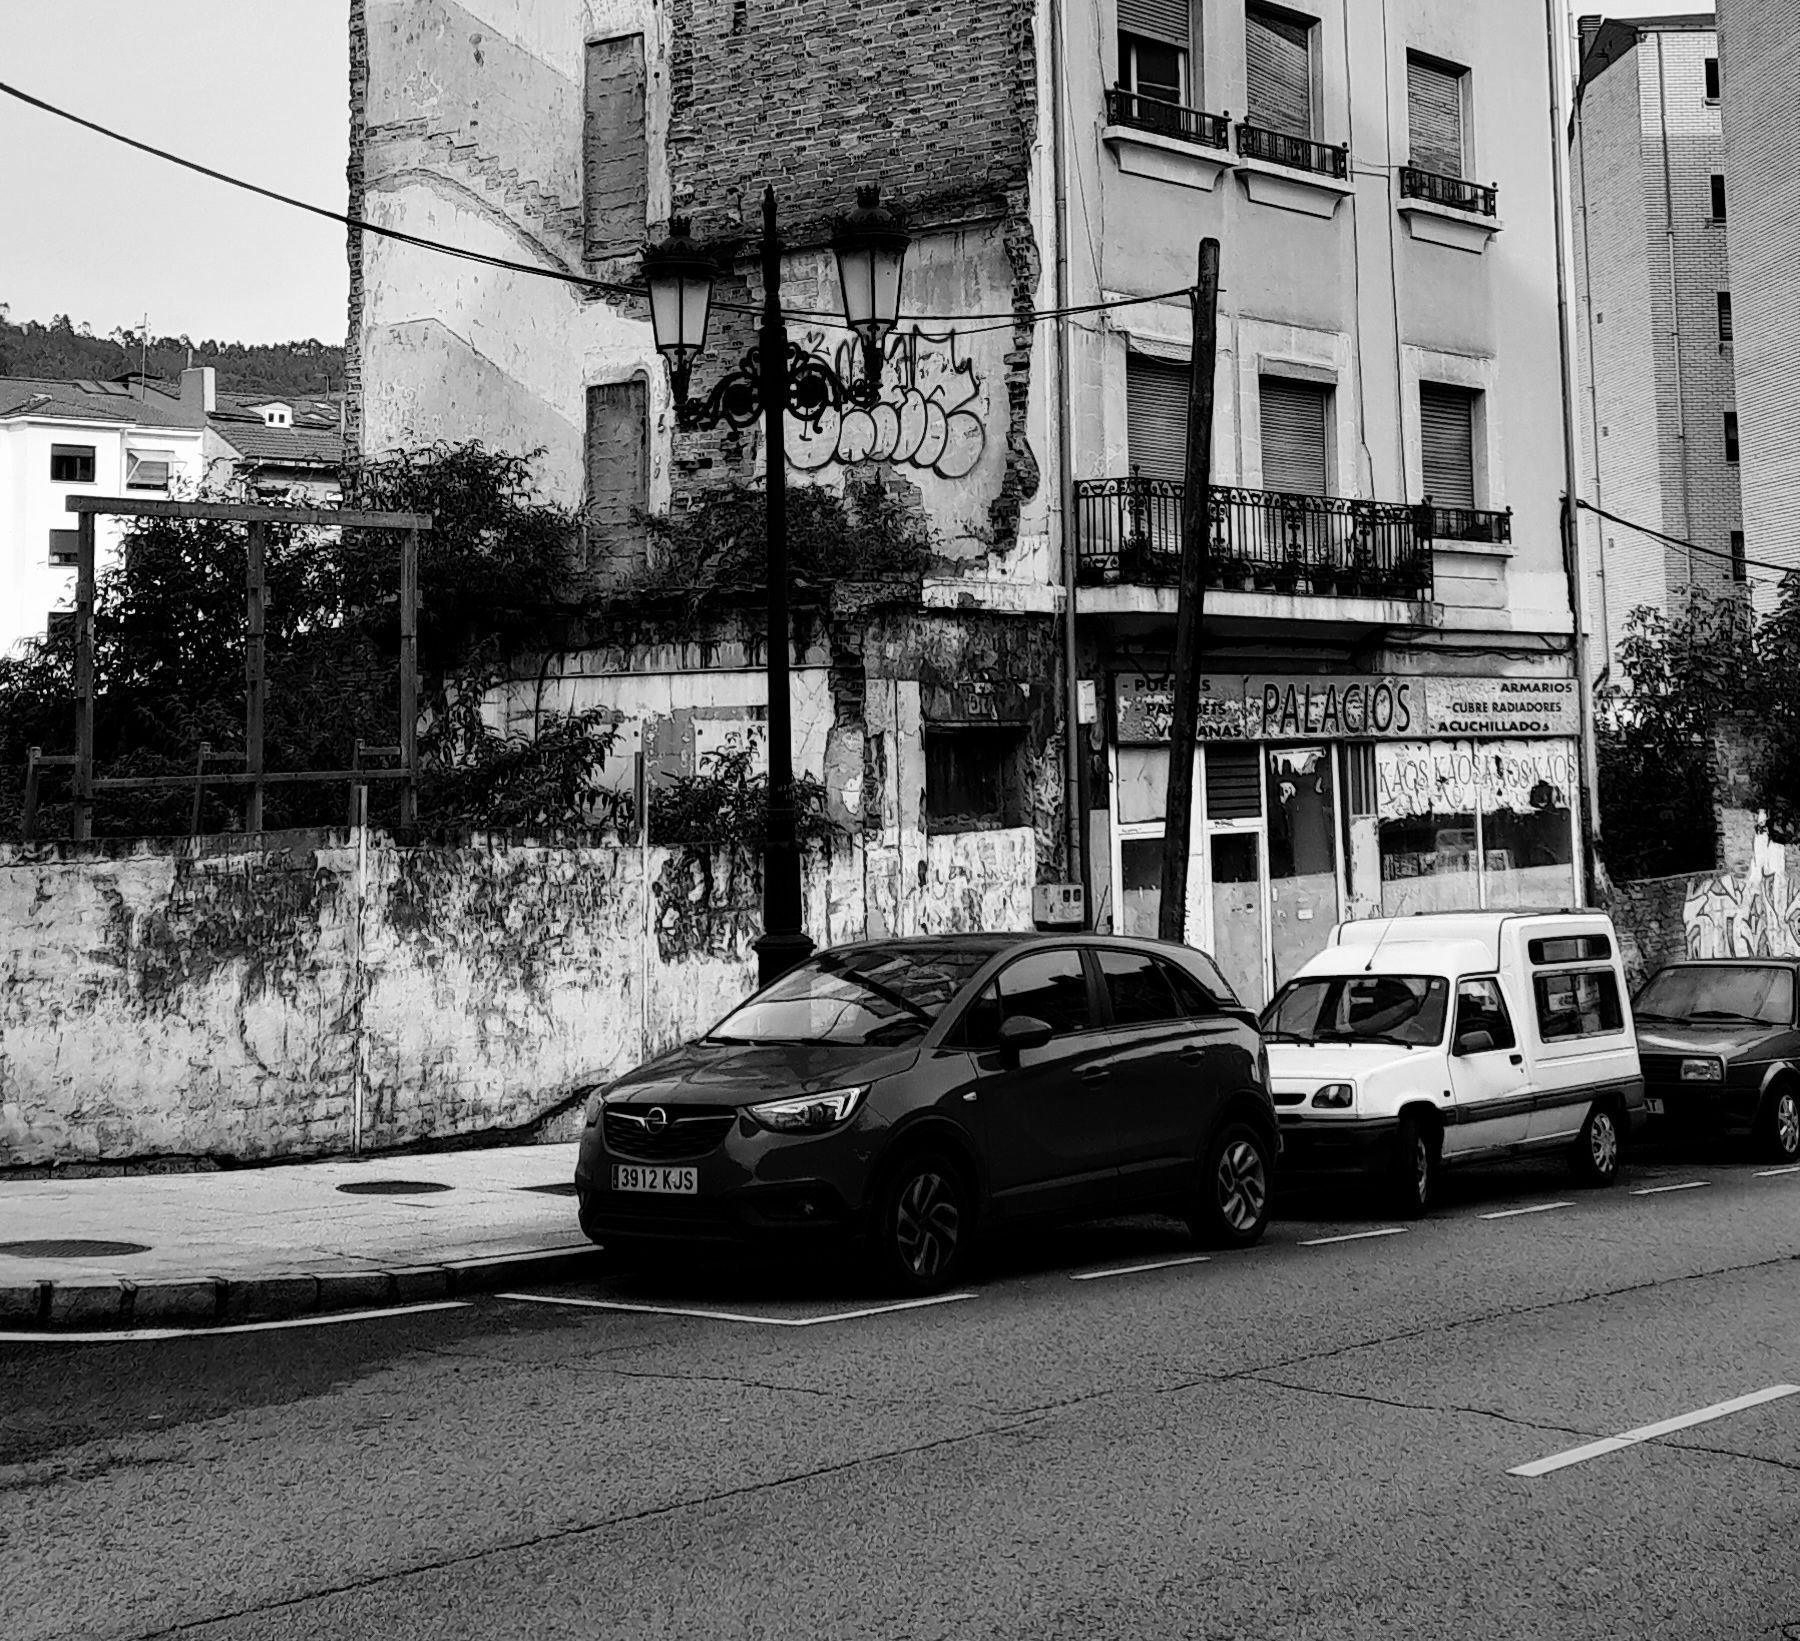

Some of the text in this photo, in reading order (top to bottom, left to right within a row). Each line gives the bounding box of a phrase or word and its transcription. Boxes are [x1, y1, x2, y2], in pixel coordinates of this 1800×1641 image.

[1134, 678, 1211, 692] PUERS
[1500, 682, 1573, 693] ARMARIOS
[1146, 703, 1227, 716] PARETS
[1262, 683, 1410, 734] PALACIOS
[1452, 702, 1562, 713] CUBRE RADIADORES
[1154, 724, 1243, 738] VANAS
[621, 1167, 694, 1191] 3912 KJS
